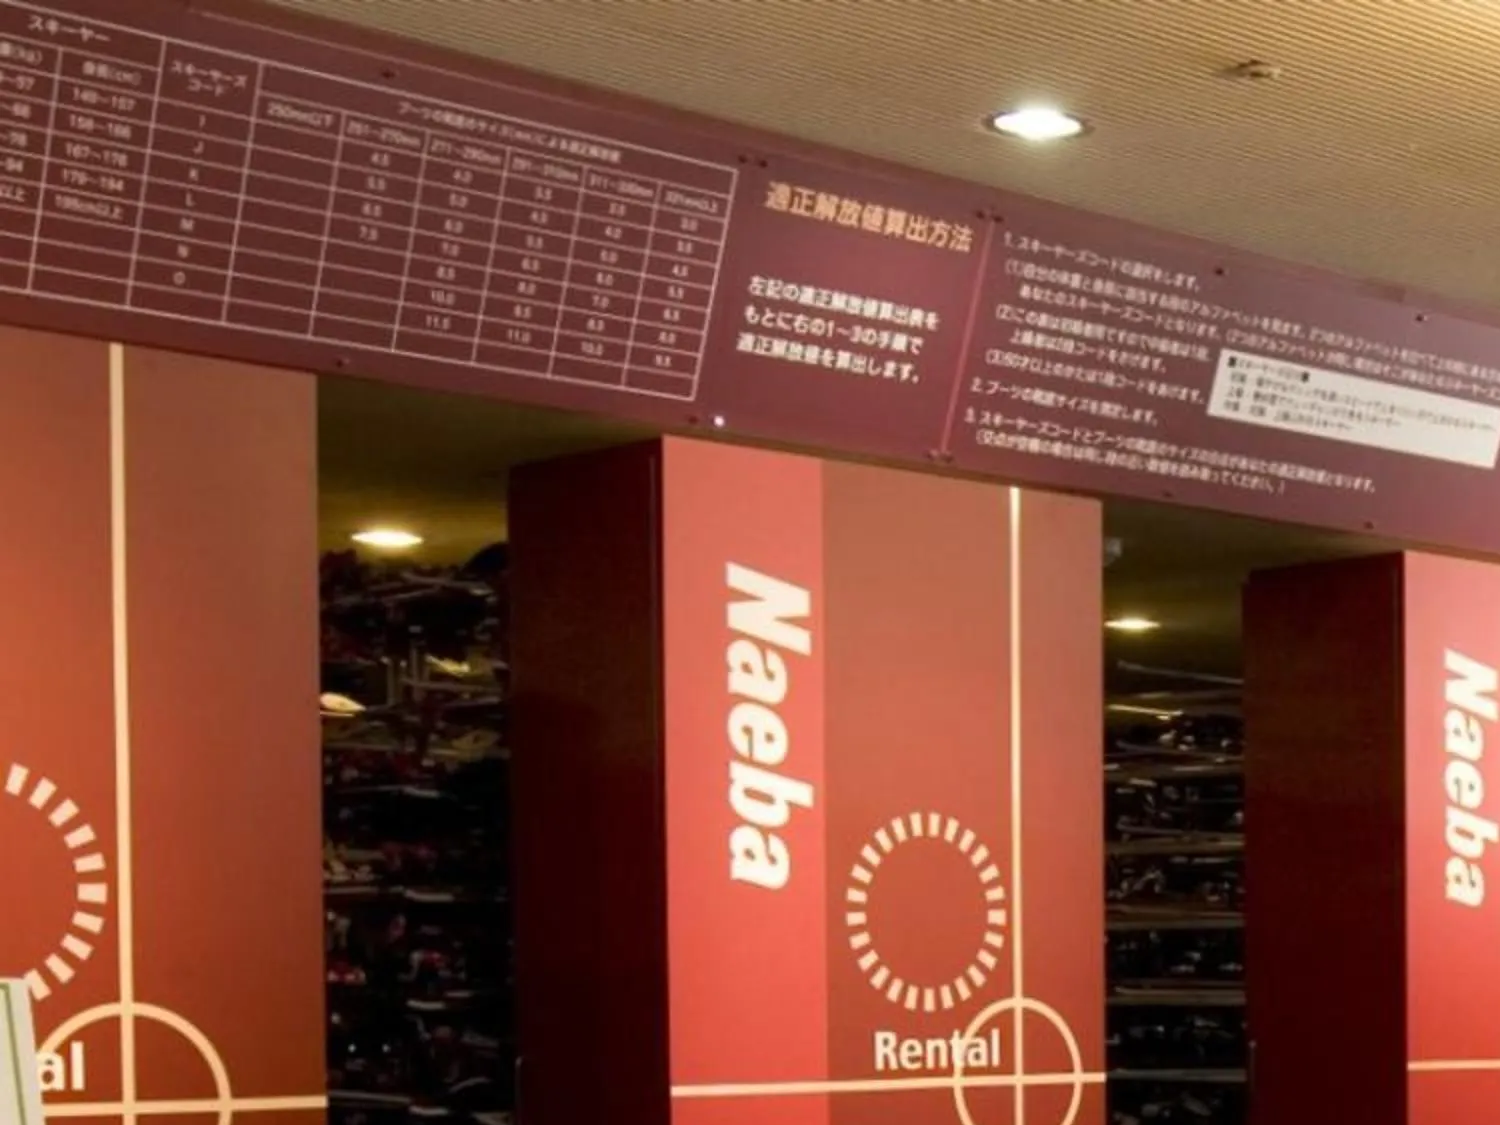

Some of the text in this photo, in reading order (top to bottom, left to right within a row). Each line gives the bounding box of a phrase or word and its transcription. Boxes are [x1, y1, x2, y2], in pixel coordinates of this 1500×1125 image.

[765, 180, 974, 252] 適正解放値算出方法
[725, 561, 815, 891] Naeba
[1443, 648, 1500, 908] Naeba
[873, 1028, 1002, 1072] Rental
